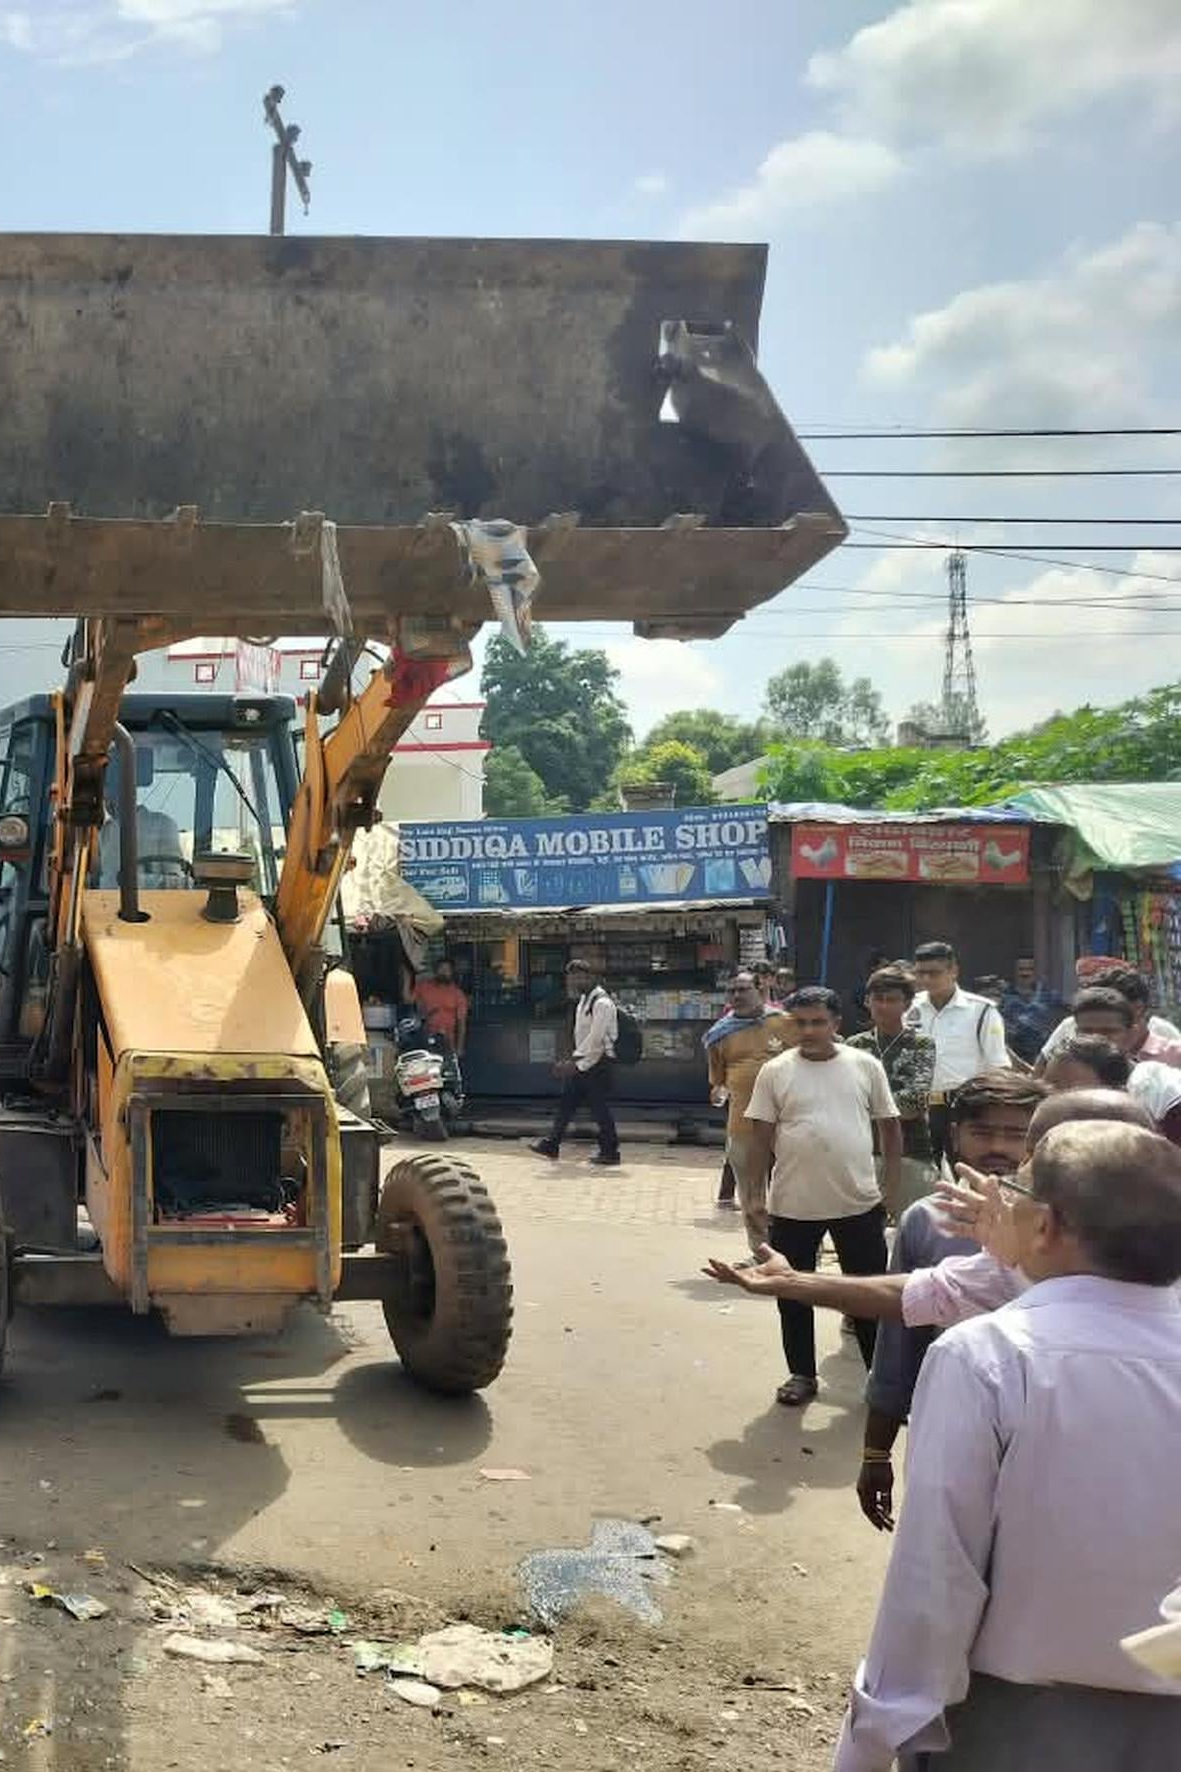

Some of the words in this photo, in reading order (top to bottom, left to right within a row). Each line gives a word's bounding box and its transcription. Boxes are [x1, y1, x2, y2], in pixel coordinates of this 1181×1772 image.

[399, 833, 530, 862] SIDDIQA
[536, 826, 666, 857] MOBILE
[675, 819, 768, 850] SHOP
